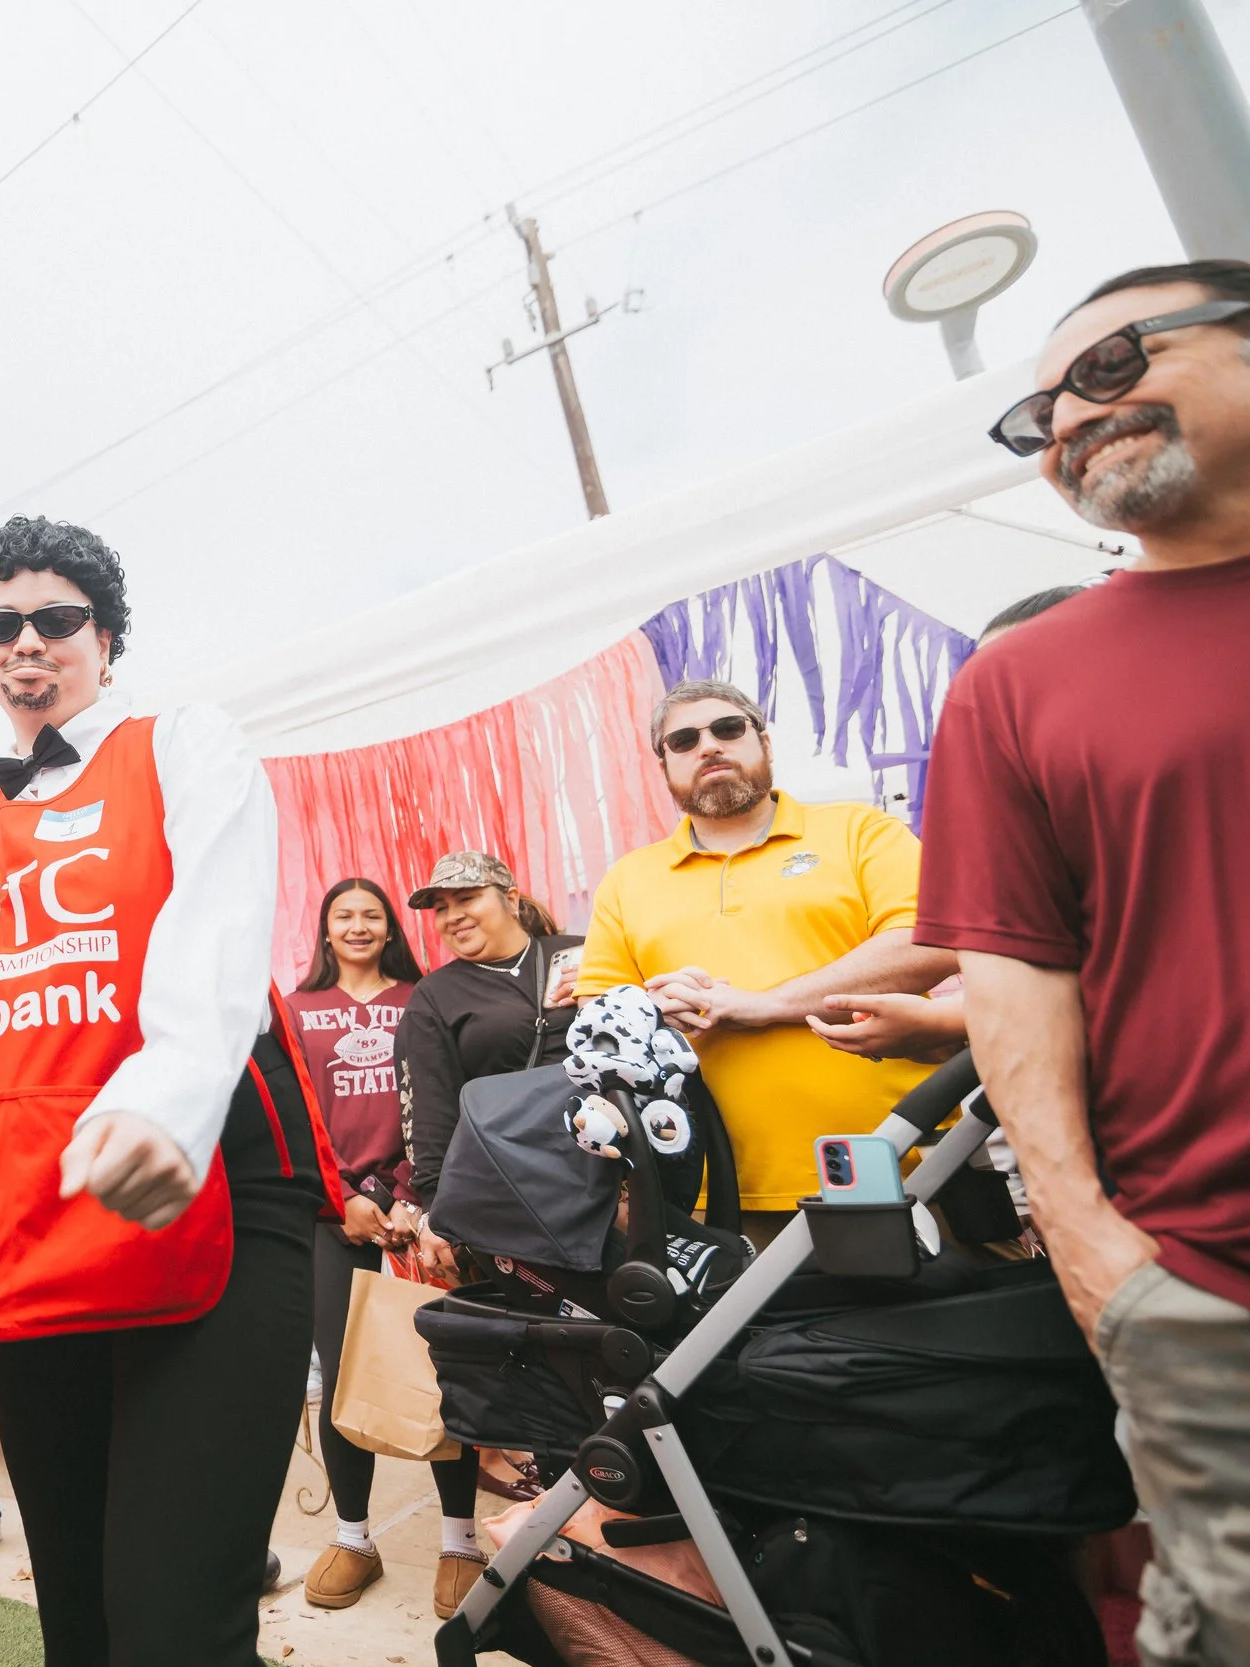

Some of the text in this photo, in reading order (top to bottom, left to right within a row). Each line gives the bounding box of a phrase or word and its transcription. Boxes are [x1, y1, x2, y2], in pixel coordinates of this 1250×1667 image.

[300, 1006, 357, 1031] NEW
[350, 1051, 390, 1063] CHAMPS
[594, 1469, 621, 1479] GRACO
